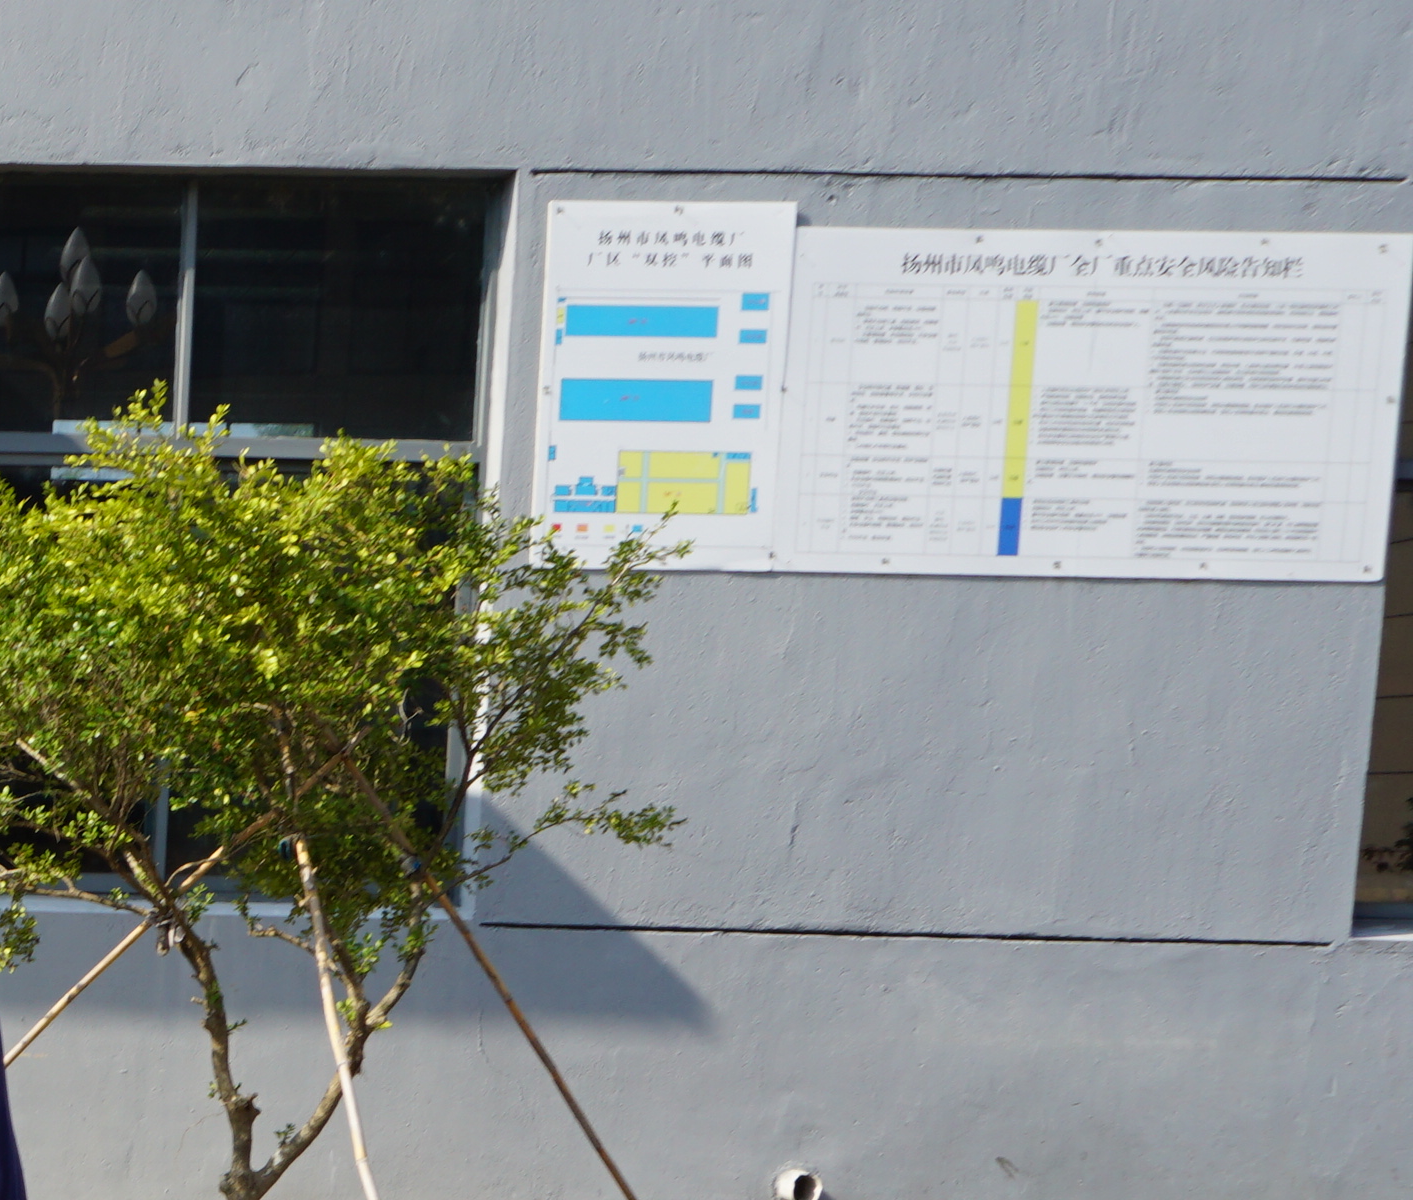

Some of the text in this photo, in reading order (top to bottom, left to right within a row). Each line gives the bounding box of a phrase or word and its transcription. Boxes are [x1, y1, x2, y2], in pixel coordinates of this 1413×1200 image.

[598, 230, 745, 246] 扬州市凤鸣电缆厂
